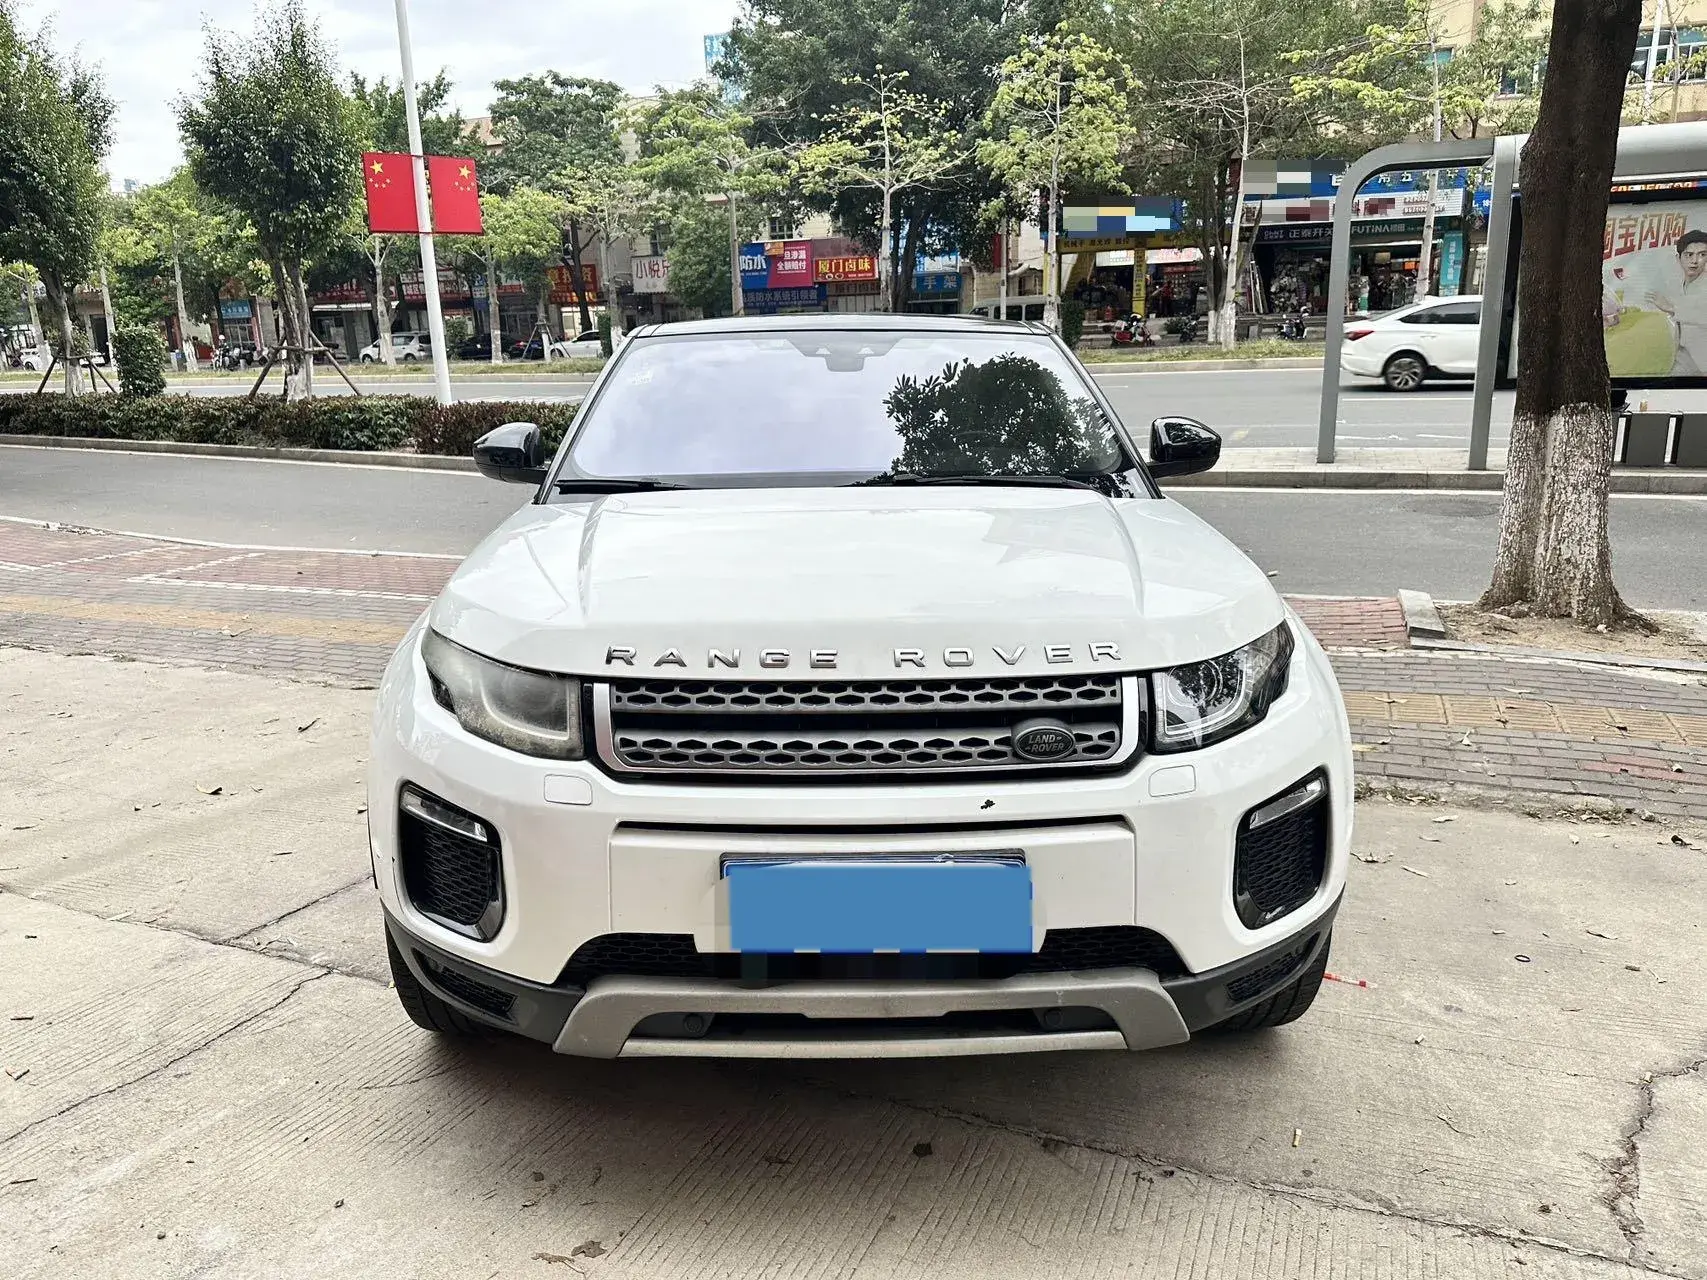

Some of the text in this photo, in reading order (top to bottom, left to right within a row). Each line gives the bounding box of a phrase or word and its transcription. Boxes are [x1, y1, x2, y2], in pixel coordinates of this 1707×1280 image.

[740, 254, 767, 271] 防水
[818, 258, 871, 273] 厦门卤味
[604, 641, 1122, 669] RANGE ROVER
[1028, 734, 1056, 745] LAND
[1030, 742, 1065, 754] ROVER
